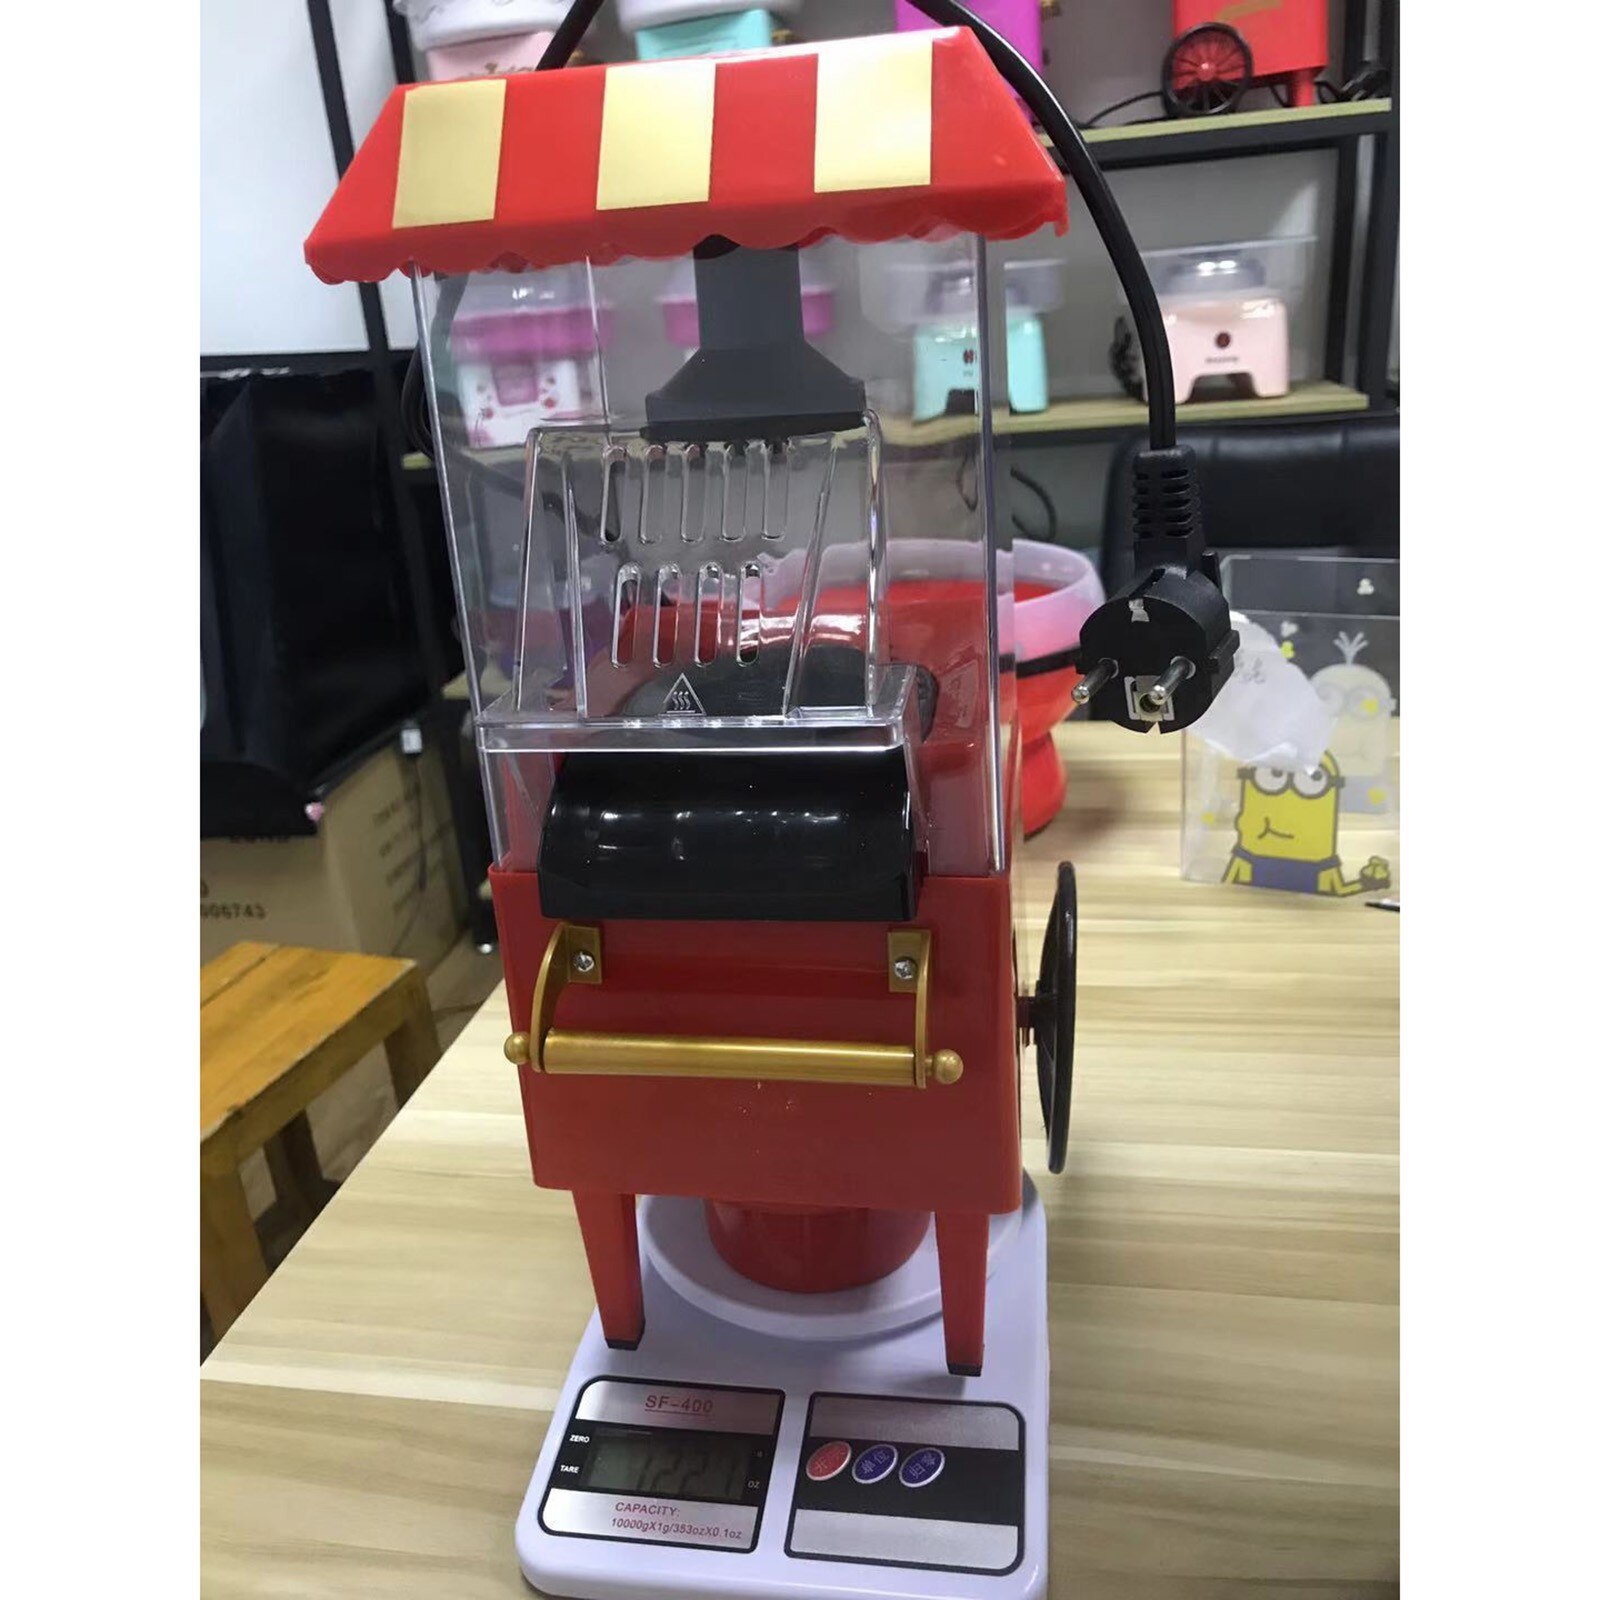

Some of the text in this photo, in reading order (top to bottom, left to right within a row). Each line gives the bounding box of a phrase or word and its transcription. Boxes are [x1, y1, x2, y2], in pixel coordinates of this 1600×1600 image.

[645, 1394, 713, 1414] SF-400
[569, 1434, 590, 1444] ZERO
[560, 1464, 580, 1474] TARE
[615, 1501, 681, 1517] CAPACITY:
